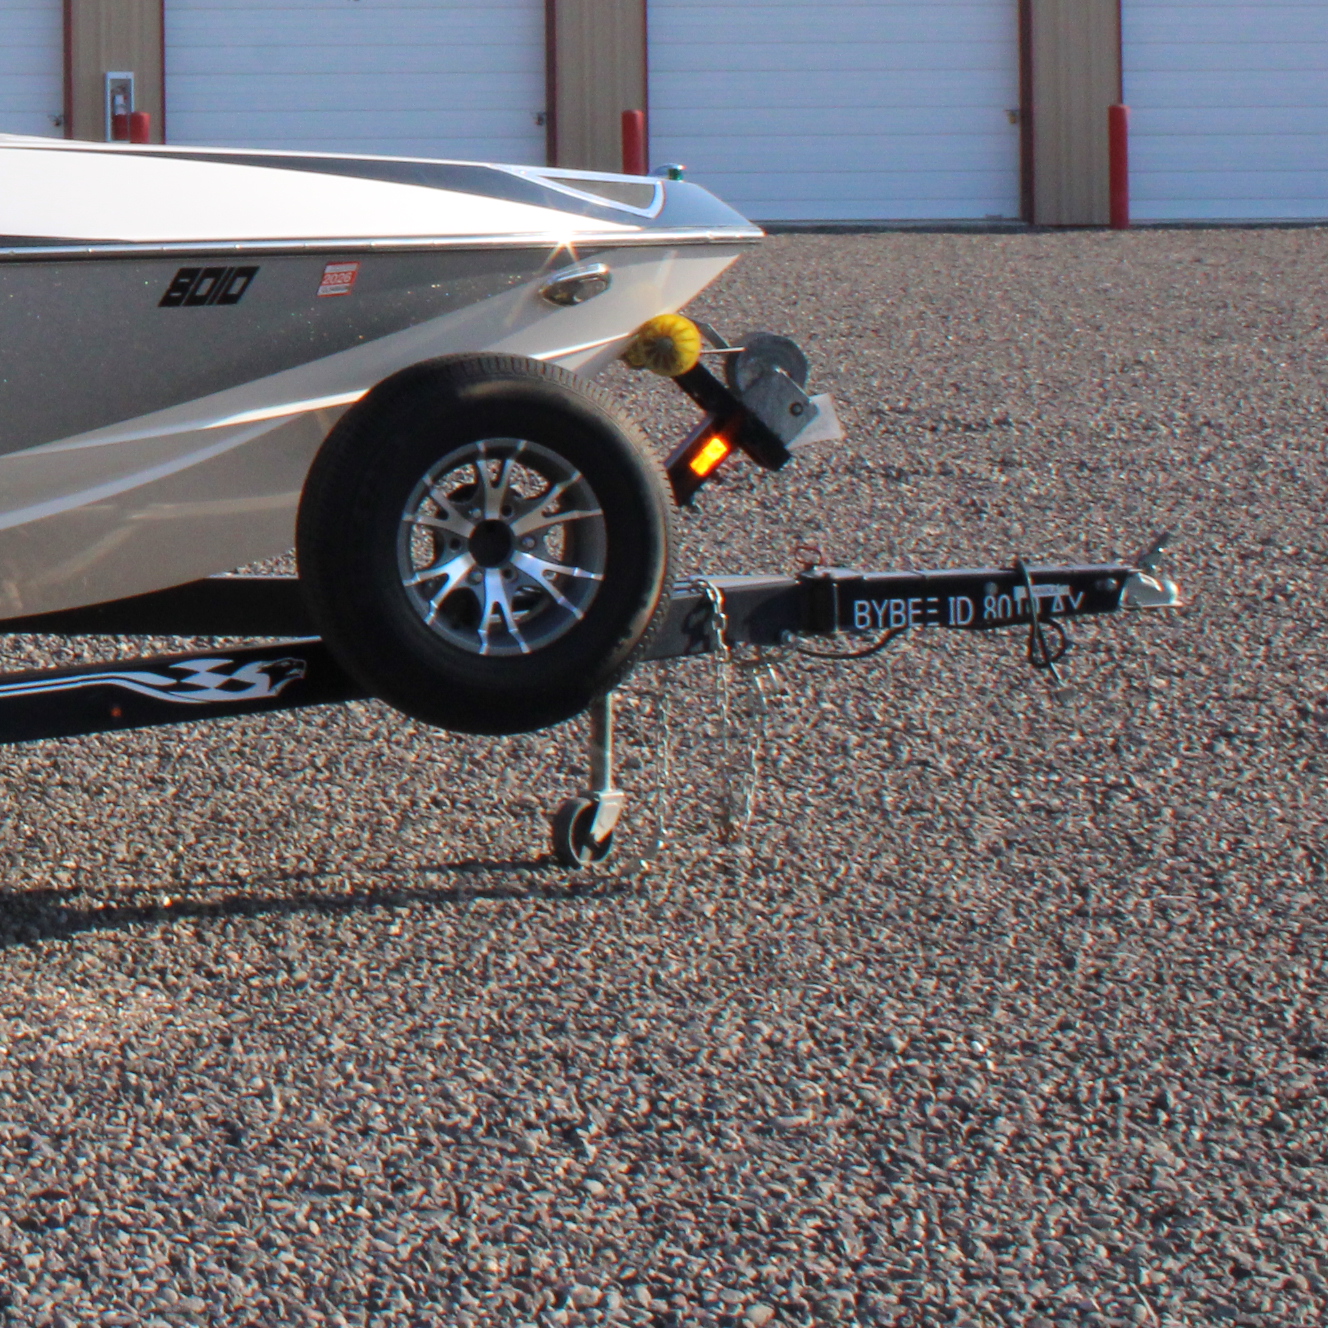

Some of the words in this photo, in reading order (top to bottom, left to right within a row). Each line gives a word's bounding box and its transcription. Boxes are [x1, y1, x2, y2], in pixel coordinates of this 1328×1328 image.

[158, 266, 260, 307] 8010
[322, 272, 353, 284] 2026
[853, 597, 941, 629] BYBEE
[948, 596, 975, 625] ID
